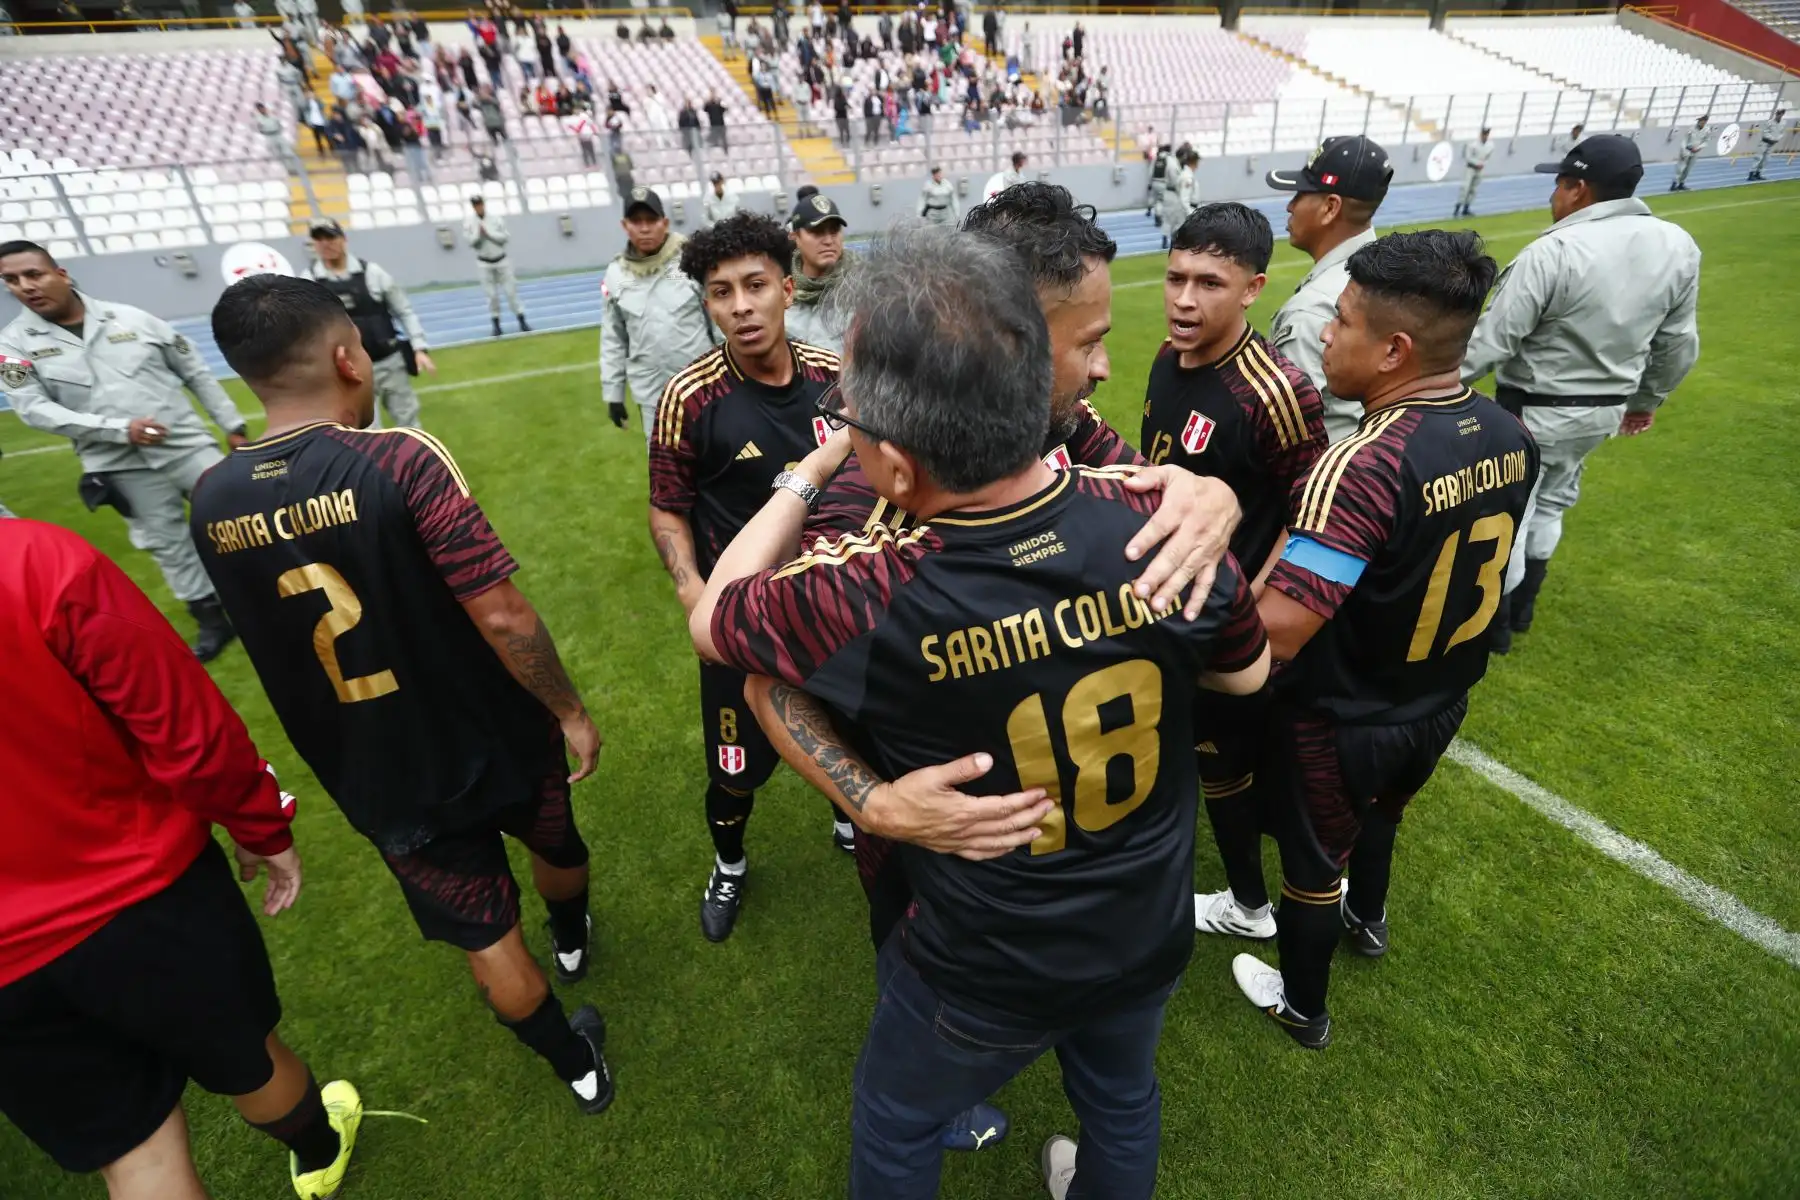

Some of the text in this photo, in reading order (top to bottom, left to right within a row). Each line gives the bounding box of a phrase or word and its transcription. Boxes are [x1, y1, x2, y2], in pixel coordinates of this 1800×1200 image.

[1456, 416, 1478, 428] UNIDOS
[251, 466, 289, 481] SIEMPRE
[254, 459, 287, 472] UNIDOS
[1422, 449, 1526, 516] SARITA COLONIA
[207, 488, 358, 554] SARITA COLONIA
[1008, 531, 1057, 556] UNIDOS
[1012, 541, 1067, 567] SIEMPRE
[1406, 511, 1514, 662] 13
[277, 562, 400, 703] 2
[920, 608, 1051, 682] SARITA
[719, 707, 738, 743] 8
[1006, 658, 1163, 856] 18
